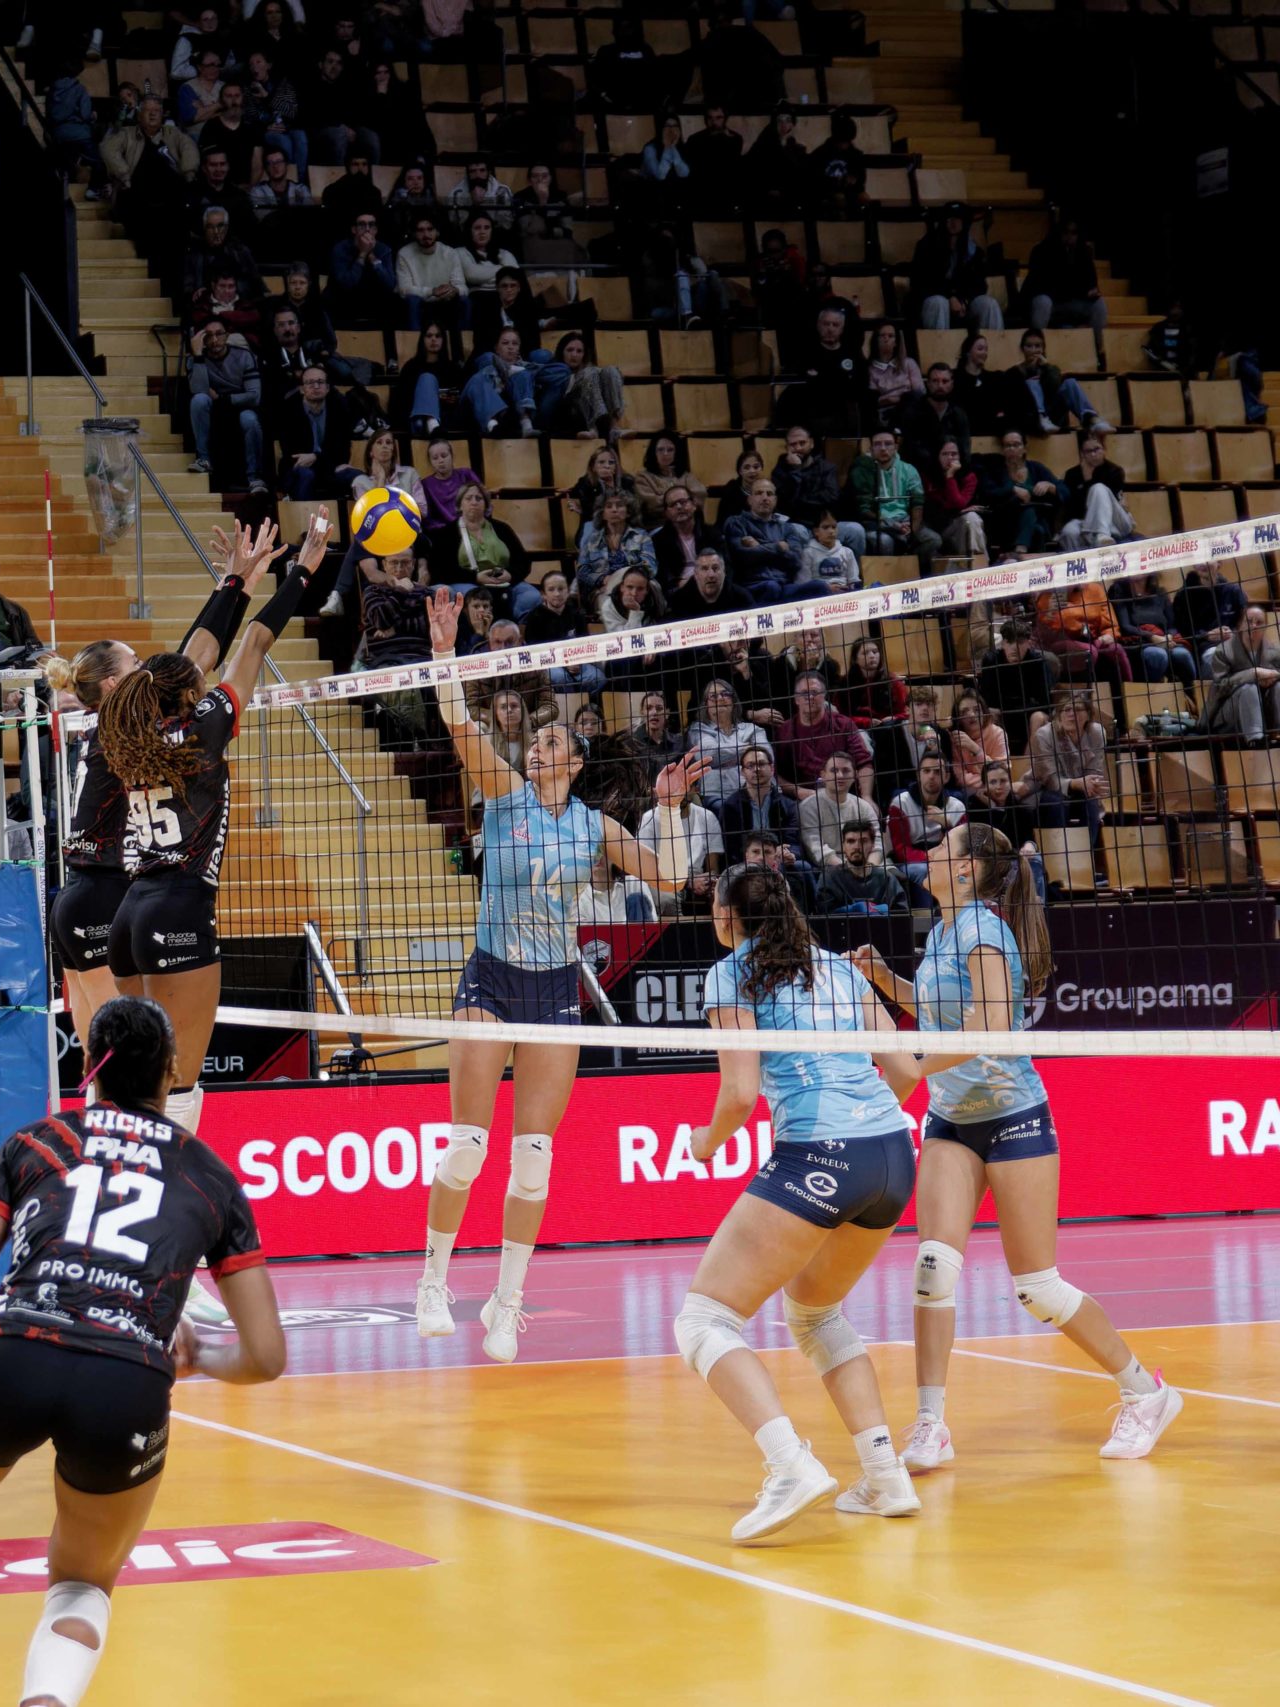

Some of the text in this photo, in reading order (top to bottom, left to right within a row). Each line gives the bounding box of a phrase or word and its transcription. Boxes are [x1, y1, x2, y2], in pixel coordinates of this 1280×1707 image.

[757, 613, 774, 630] PHA
[901, 588, 920, 604] PHA
[973, 572, 1018, 588] CHAMALIÈRES
[1029, 575, 1048, 587] power
[1066, 558, 1087, 577] PHA
[1101, 563, 1122, 577] power
[1148, 540, 1198, 560] CHAMALIÈRES
[1212, 545, 1233, 557] power
[1254, 523, 1279, 543] PHA
[635, 974, 707, 1023] CLE
[1056, 982, 1233, 1016] Groupama
[202, 1056, 244, 1072] EUR
[85, 1110, 173, 1141] RICKS
[84, 1135, 162, 1170] PHA
[619, 1120, 772, 1183] RADI
[65, 1164, 165, 1263] 12
[785, 1182, 840, 1215] Groupama
[38, 1260, 144, 1298] PRO IMMO
